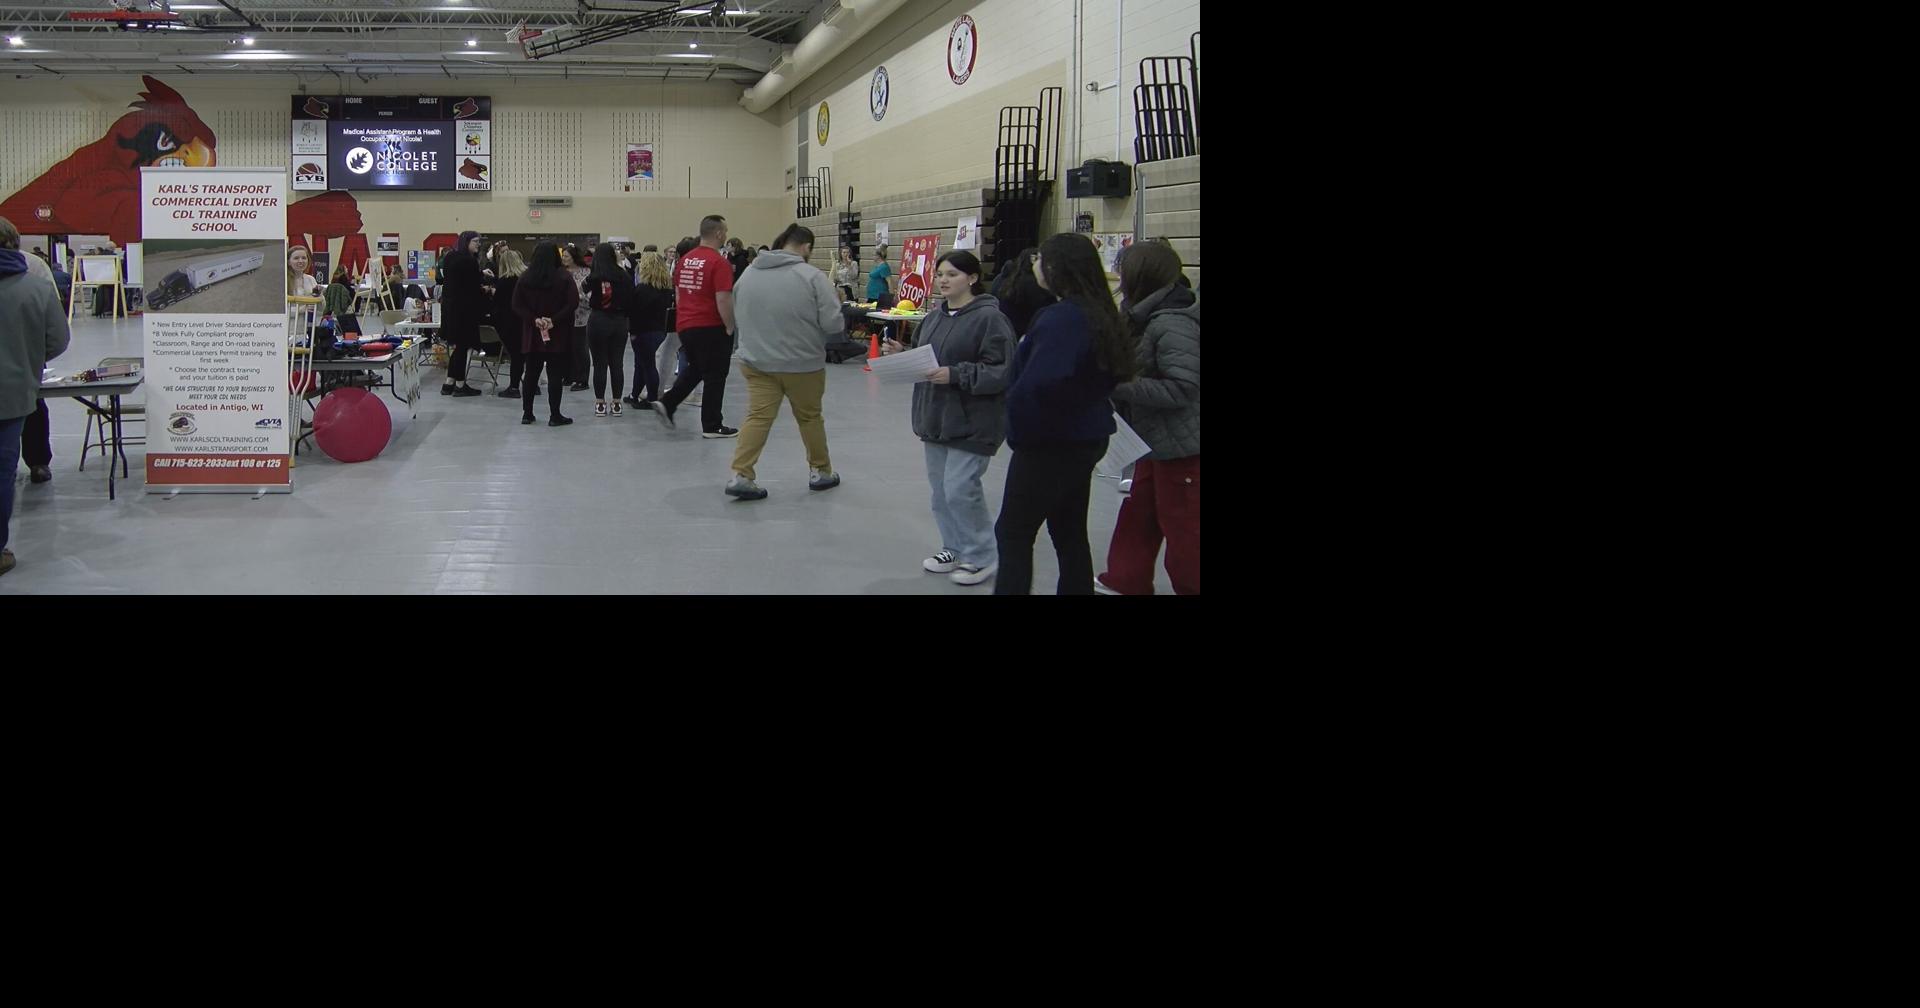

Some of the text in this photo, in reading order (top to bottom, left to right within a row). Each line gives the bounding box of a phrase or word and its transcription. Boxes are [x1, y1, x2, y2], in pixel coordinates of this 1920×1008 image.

[392, 128, 416, 136] Program
[376, 151, 438, 161] NICOLET
[376, 161, 438, 171] COLLEGE
[158, 184, 272, 194] KARL'S TRANSPORT
[457, 182, 489, 190] AVAILABLE
[152, 197, 278, 207] COMMERCIAL DRIVER
[172, 210, 258, 219] CDL TRAINING
[191, 222, 238, 232] SCHOOL
[683, 258, 706, 268] STATE
[900, 282, 924, 302] STOP
[190, 340, 211, 348] Range
[251, 340, 275, 348] training
[176, 403, 264, 412] Located in Antigo, WI
[255, 458, 266, 468] or
[266, 458, 281, 468] 125
